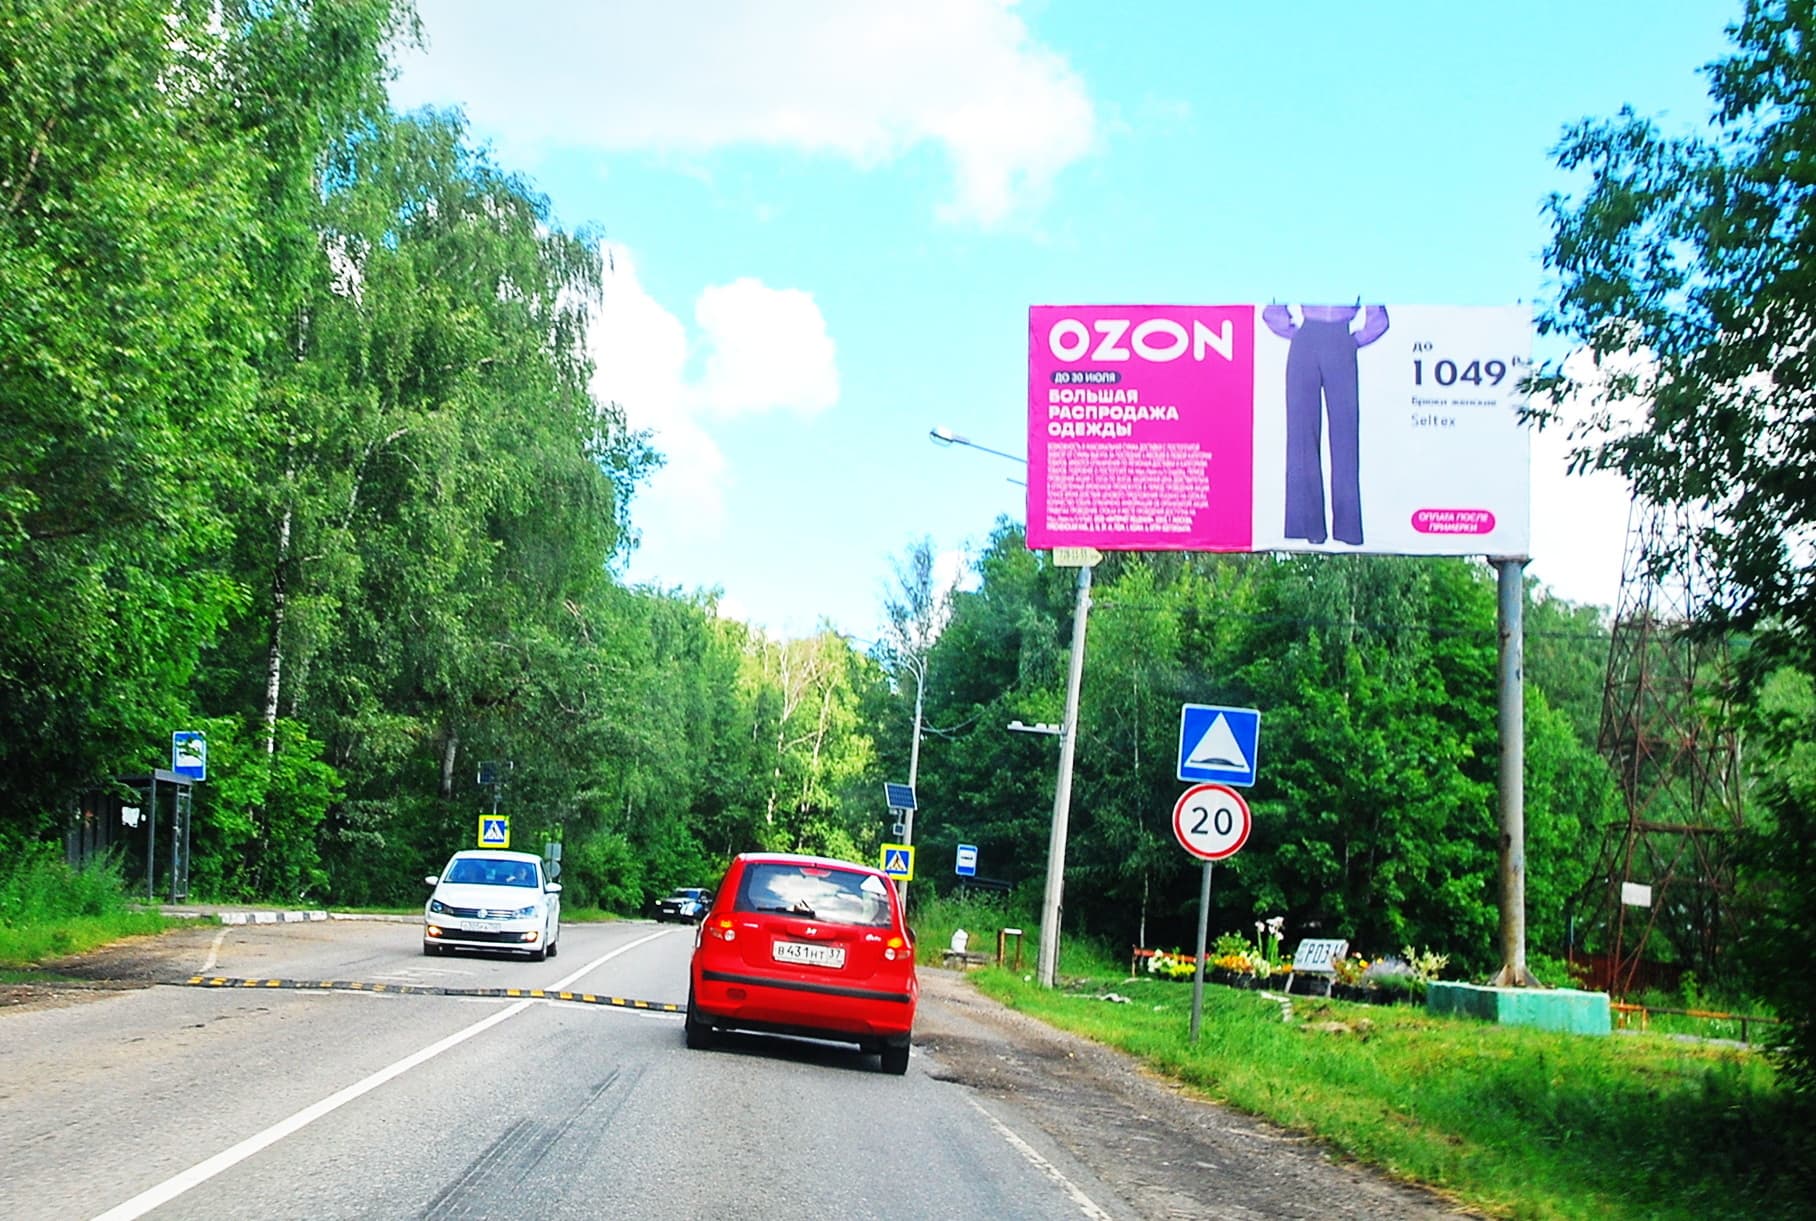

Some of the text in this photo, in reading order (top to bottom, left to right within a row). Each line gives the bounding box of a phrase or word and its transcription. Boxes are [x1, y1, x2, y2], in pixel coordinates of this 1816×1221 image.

[1049, 318, 1233, 362] OZON
[1054, 371, 1070, 384] ДО
[1085, 371, 1116, 383] ИЮЛЯ
[1048, 388, 1139, 403] БОЛЬШАЯ
[1048, 404, 1179, 422] РАСПРОДАЖА
[1047, 421, 1133, 438] ОДЕЖДЫ
[1190, 806, 1233, 836] 20
